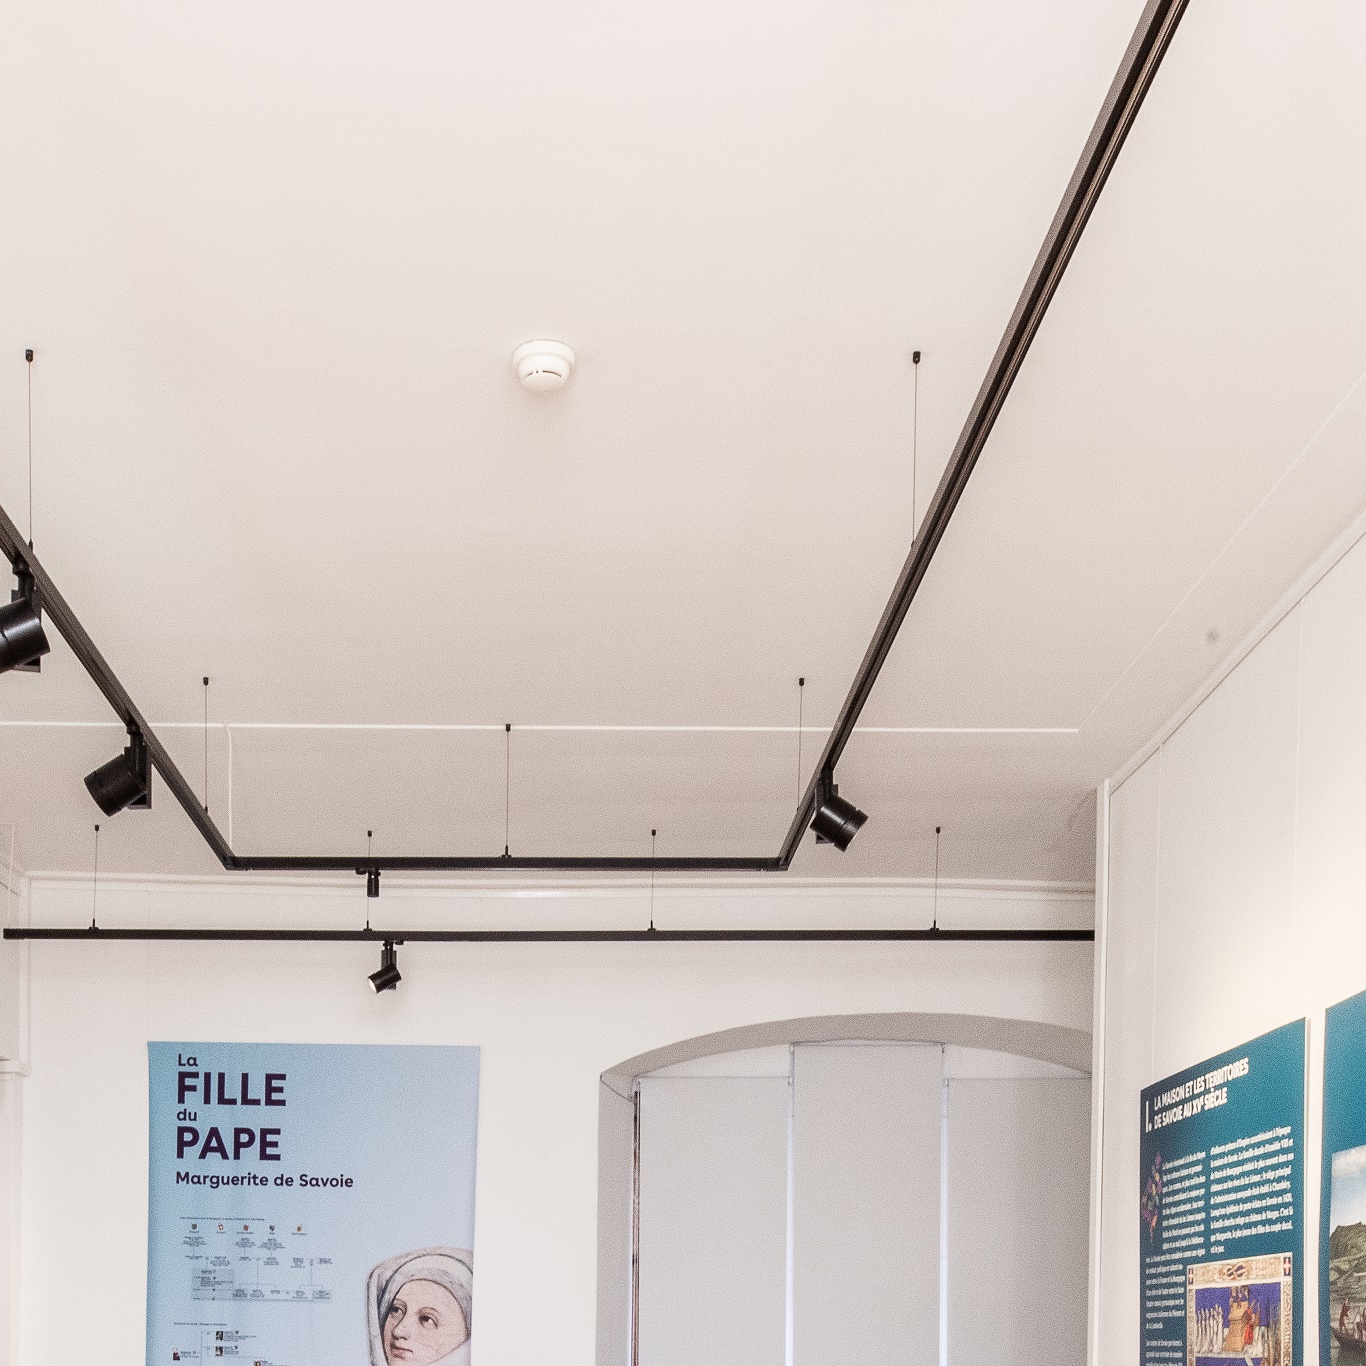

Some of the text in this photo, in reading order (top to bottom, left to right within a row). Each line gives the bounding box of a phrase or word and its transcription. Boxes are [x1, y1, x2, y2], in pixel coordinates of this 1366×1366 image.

[178, 1053, 198, 1067] La
[177, 1071, 287, 1106] FILLE
[1154, 1057, 1249, 1110] LA MAISON ET LES TERRITOIRES
[176, 1108, 197, 1121] du
[1154, 1113, 1162, 1129] DE
[1162, 1105, 1183, 1127] SAVOIE
[1183, 1101, 1192, 1118] AU
[1204, 1087, 1228, 1111] SIÈCLE
[176, 1126, 281, 1161] PAPE
[176, 1171, 354, 1189] Marguerite de Savoie
